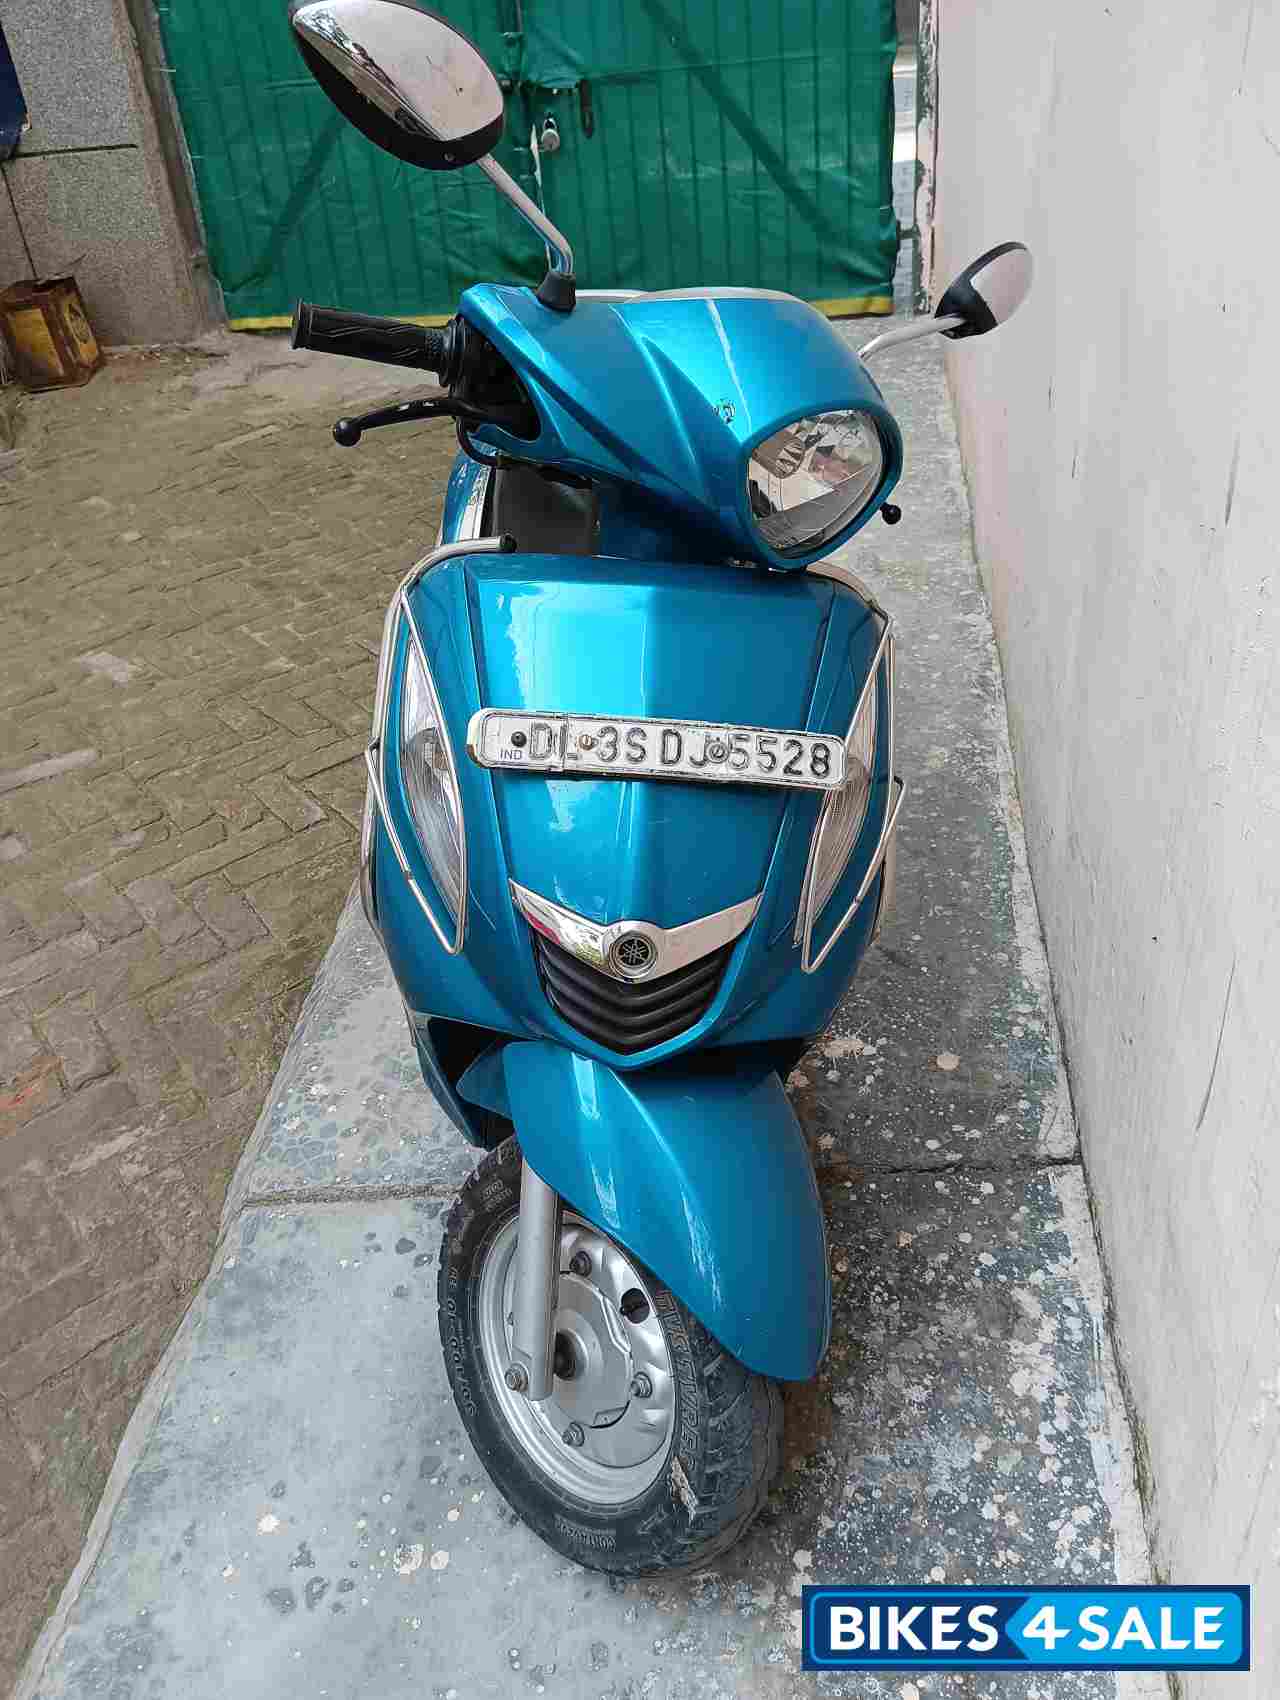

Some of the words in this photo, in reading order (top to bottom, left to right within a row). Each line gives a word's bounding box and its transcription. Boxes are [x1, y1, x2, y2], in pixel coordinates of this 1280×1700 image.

[500, 749, 522, 760] IND
[598, 725, 647, 763] 3S
[661, 728, 708, 768] DJ
[727, 733, 832, 779] 5528
